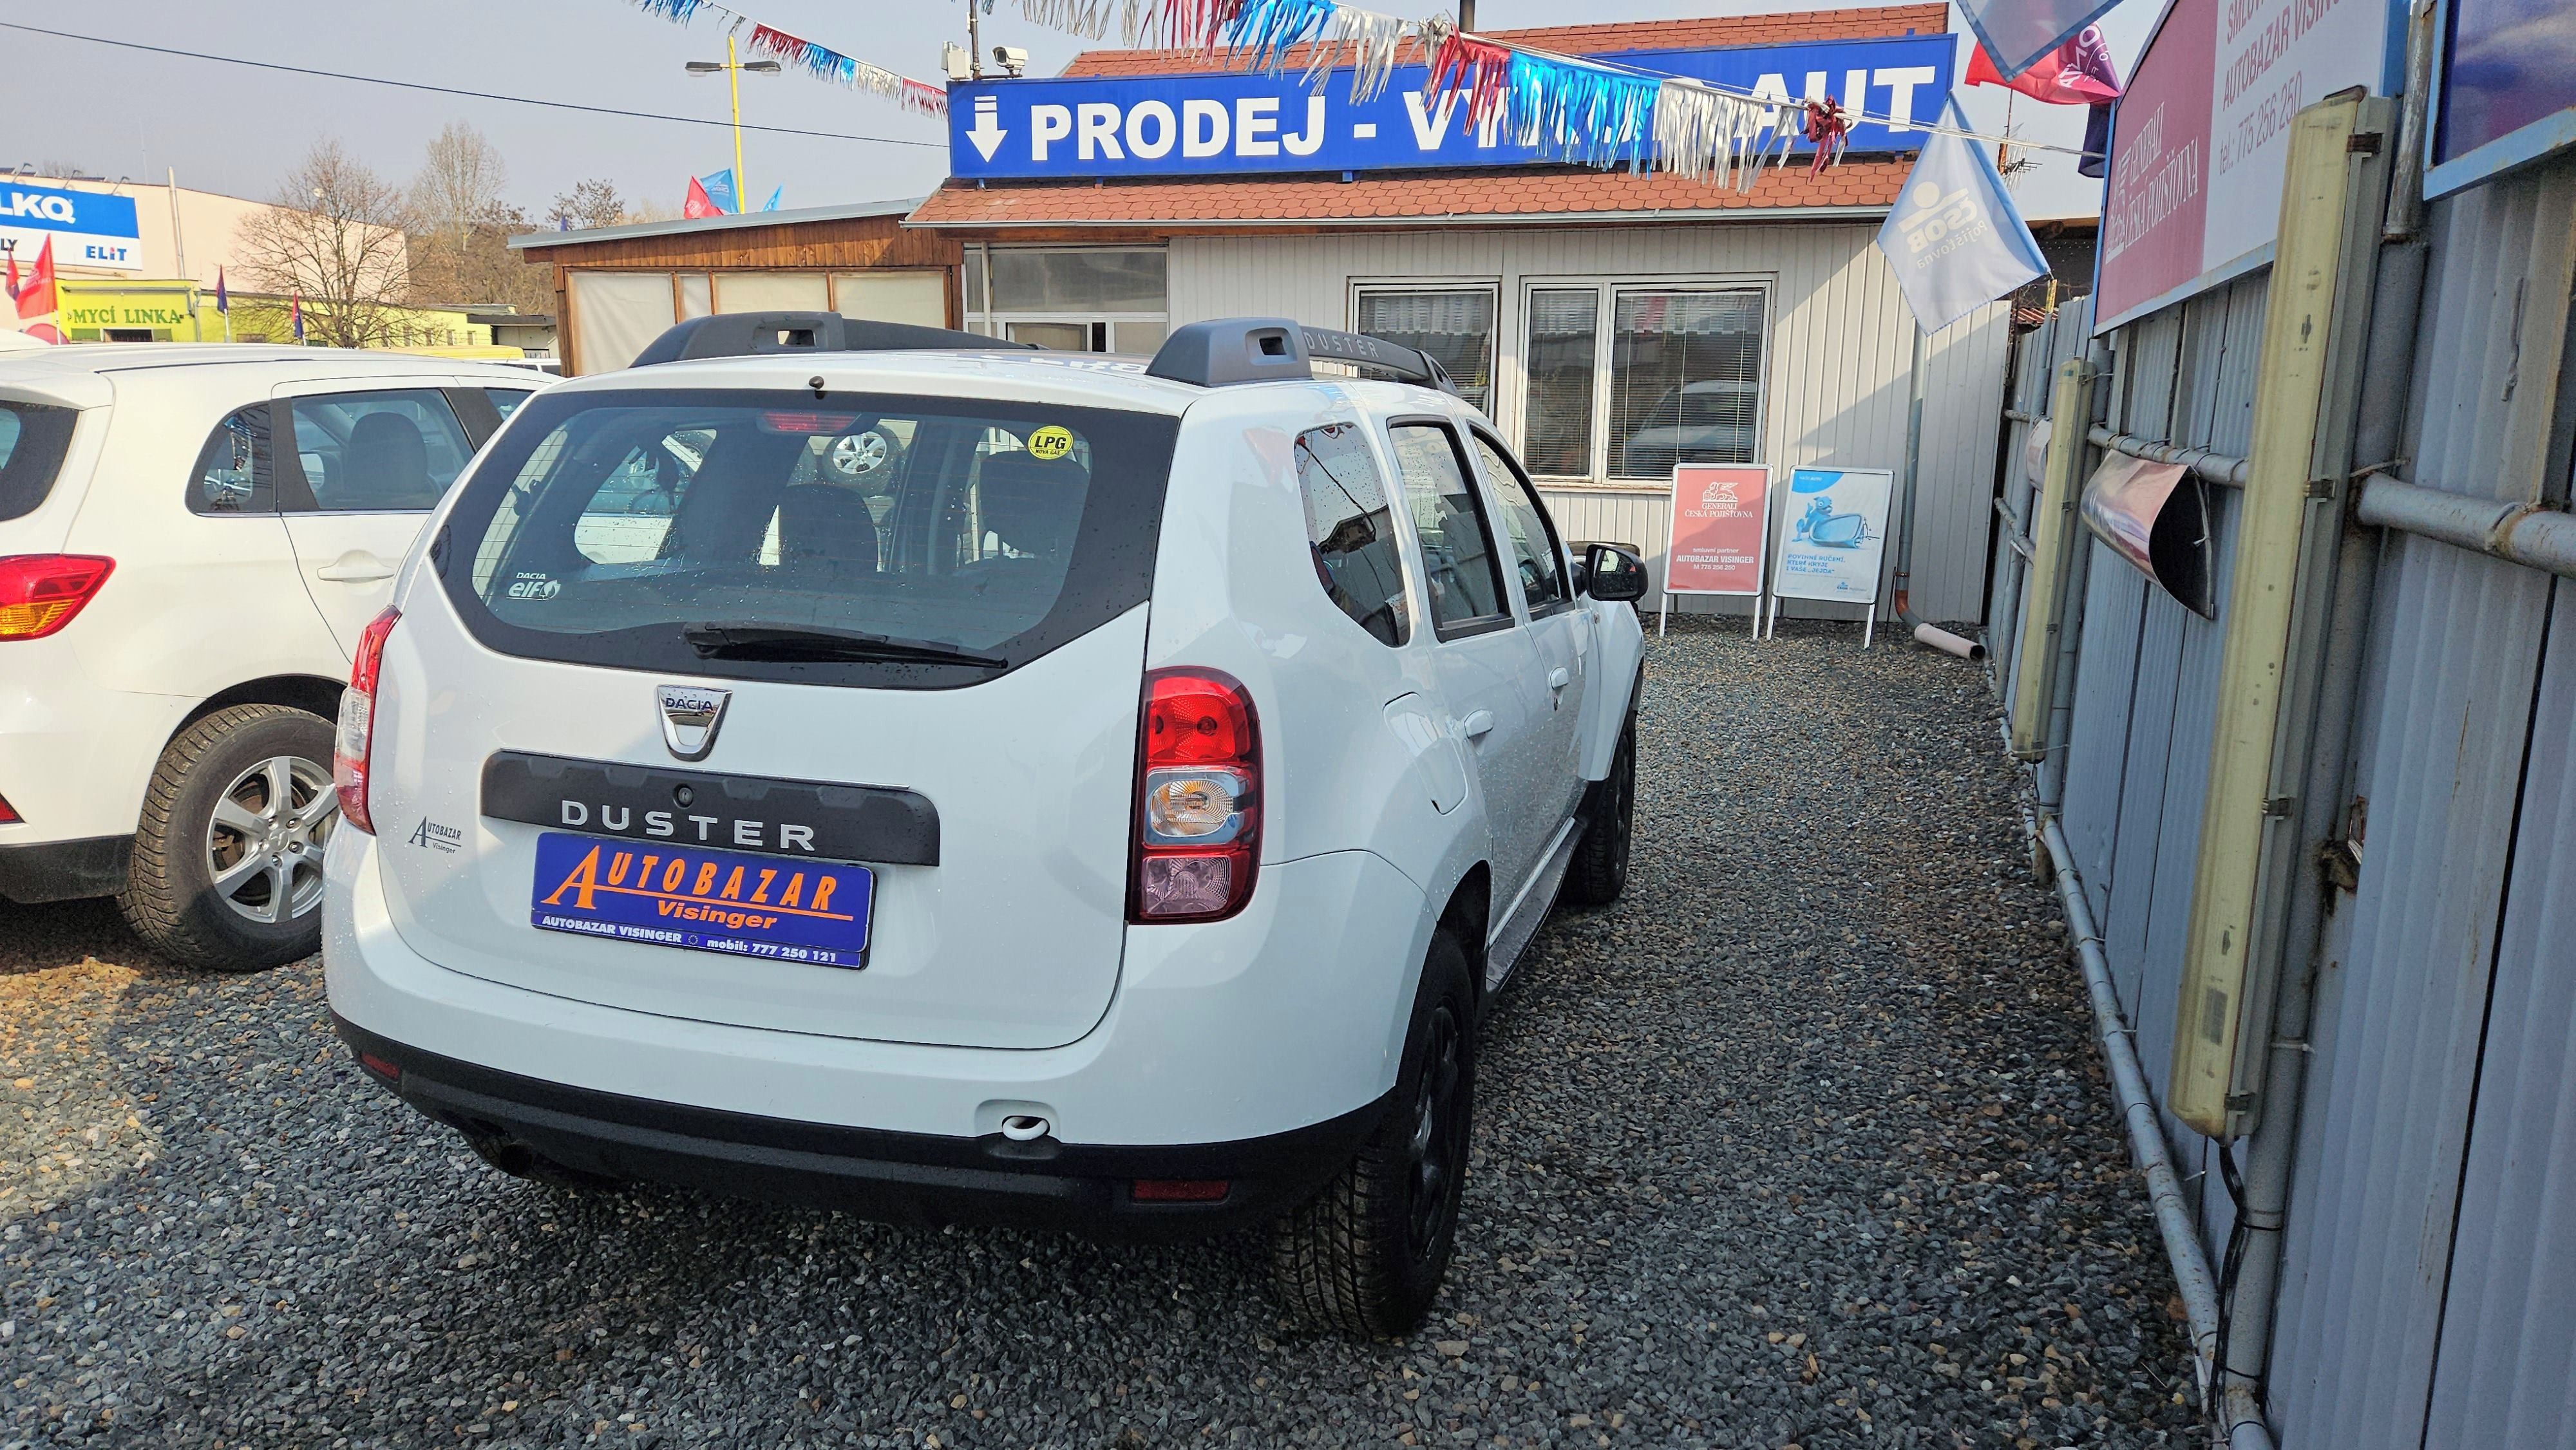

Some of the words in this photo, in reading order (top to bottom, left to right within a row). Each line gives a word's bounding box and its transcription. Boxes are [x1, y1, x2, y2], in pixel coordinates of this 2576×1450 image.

[2223, 5, 2290, 112] AUTOBAZAR
[1031, 95, 1327, 162] PRODEJ
[1734, 66, 1936, 140] AUT
[2237, 111, 2255, 162] 775
[2256, 92, 2277, 148] 256
[2278, 70, 2303, 131] 250
[73, 306, 116, 324] MYCÍ
[124, 308, 182, 324] LINKA
[1303, 332, 1379, 359] DUSTER
[1034, 435, 1066, 449] LPG
[1685, 509, 1708, 518] ČESKÁ
[1709, 509, 1753, 518] POJIŠŤOVNA
[1676, 555, 1719, 563] AUTOBAZAR
[1720, 556, 1754, 564] VISINGER
[508, 581, 544, 598] elf
[665, 697, 714, 711] DACIA
[408, 815, 462, 849] AUTOBAZAR
[560, 799, 816, 852] DUSTER
[433, 842, 456, 854] Visinger
[540, 845, 838, 911] AUTOBAZAR
[657, 900, 778, 929] Visinger
[541, 916, 616, 934] AUTOBAZAR
[618, 926, 683, 943] VISINGER
[706, 939, 748, 952] mobil:
[752, 943, 777, 956] 777
[781, 946, 808, 959] 250
[812, 950, 837, 963] 121
